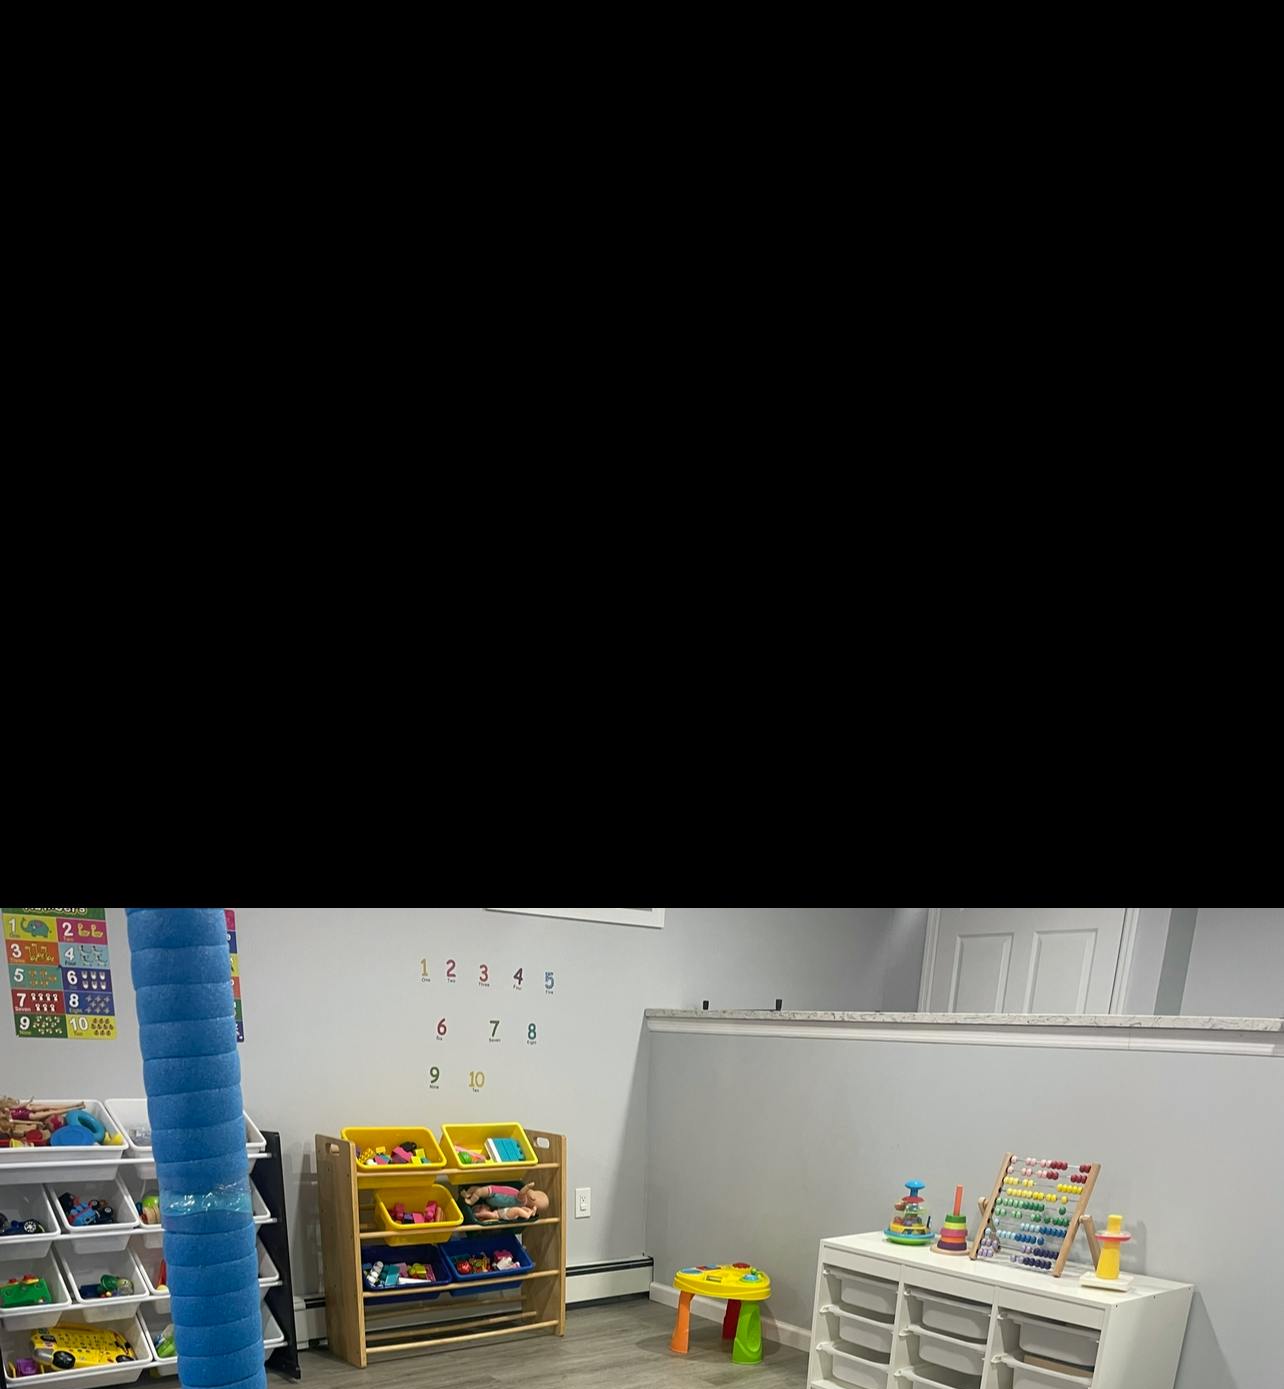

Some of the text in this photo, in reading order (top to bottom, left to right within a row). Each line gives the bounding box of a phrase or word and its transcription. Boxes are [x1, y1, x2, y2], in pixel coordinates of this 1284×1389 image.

[9, 919, 16, 933] 1
[62, 922, 74, 937] 2
[10, 943, 22, 959] 3
[64, 947, 75, 961] 4
[14, 968, 24, 982] 5
[420, 958, 429, 977] 1
[446, 959, 457, 978] 2
[479, 964, 489, 983] 3
[67, 970, 78, 985] 6
[513, 967, 524, 985] 4
[544, 971, 555, 990] 5
[16, 993, 27, 1008] 7
[69, 993, 79, 1008] 8
[19, 1016, 31, 1031] 9
[70, 1017, 88, 1031] 10
[436, 1018, 447, 1036] 6
[489, 1020, 500, 1038] 7
[527, 1023, 537, 1040] 8
[429, 1066, 440, 1084] 9
[468, 1071, 485, 1089] 10
